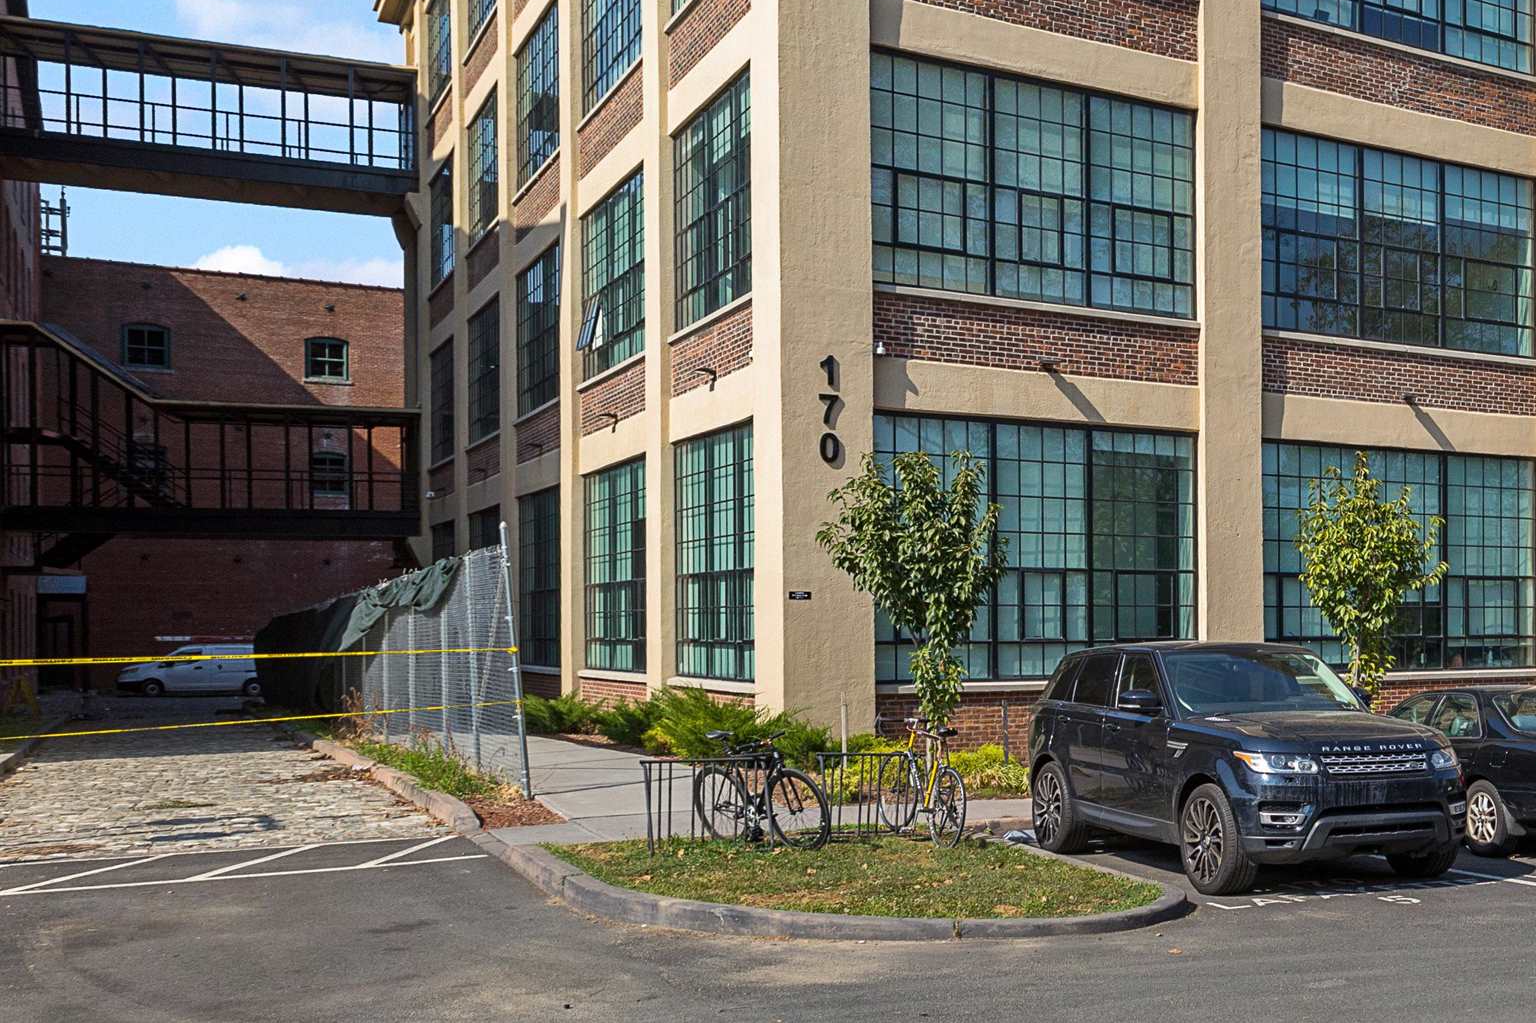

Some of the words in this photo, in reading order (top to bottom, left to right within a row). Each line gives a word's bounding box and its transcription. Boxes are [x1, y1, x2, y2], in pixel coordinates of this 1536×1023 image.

[818, 354, 842, 467] 170
[1321, 745, 1371, 753] RANGE
[1379, 743, 1422, 751] ROVER
[1377, 894, 1421, 905] 5
